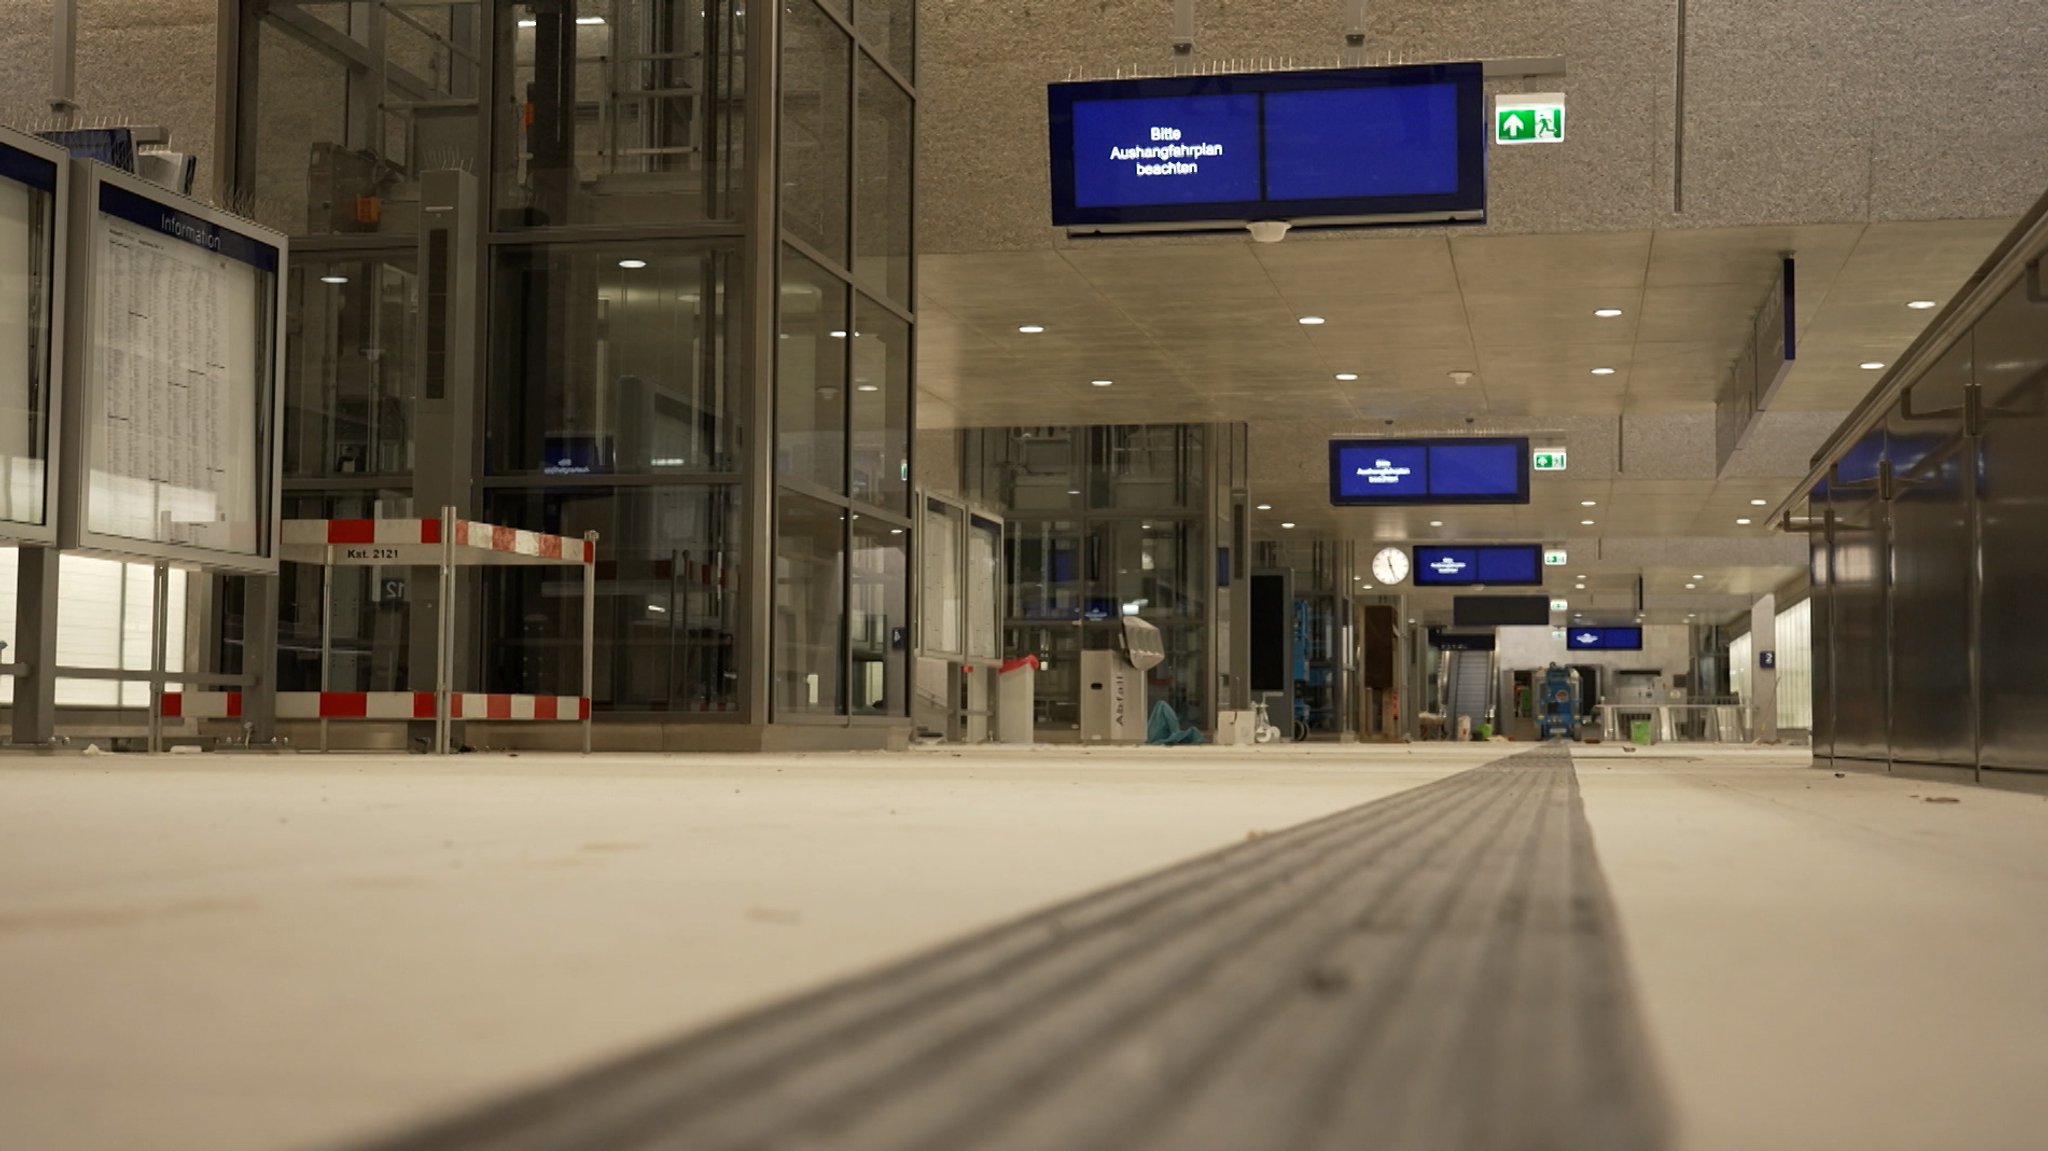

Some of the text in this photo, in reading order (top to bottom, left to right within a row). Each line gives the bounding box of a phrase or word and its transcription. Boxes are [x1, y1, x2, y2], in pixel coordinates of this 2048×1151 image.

[1150, 126, 1182, 141] Bitte
[1109, 142, 1223, 161] Aushangfahrplan
[1136, 161, 1198, 176] beachten
[161, 212, 221, 250] Information
[373, 549, 398, 559] 2121
